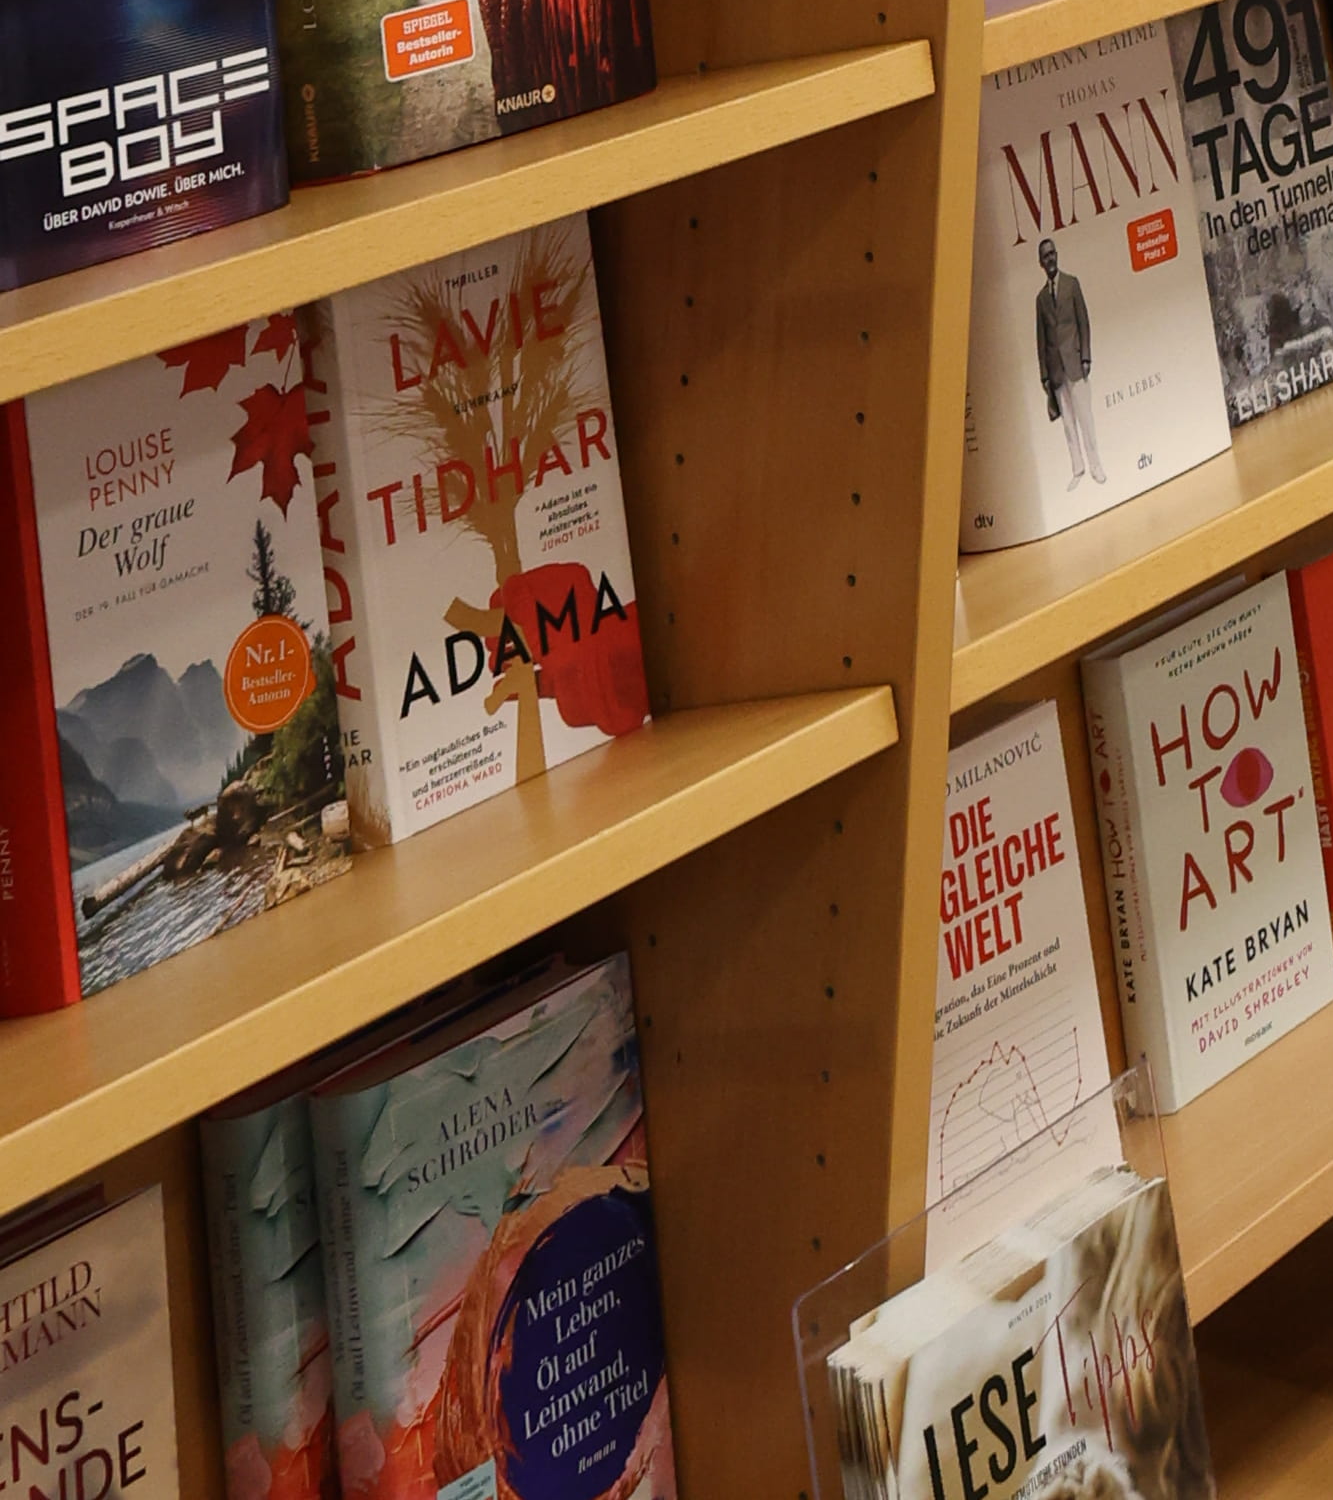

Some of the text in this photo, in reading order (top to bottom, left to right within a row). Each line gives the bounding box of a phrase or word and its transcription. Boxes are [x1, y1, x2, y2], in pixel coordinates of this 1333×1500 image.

[61, 112, 224, 196] BOY
[1001, 88, 1179, 246] MANN
[42, 161, 245, 231] ÜBER DAVID BOWIE. ÜBER MICH.
[445, 264, 498, 290] THRILLER
[1247, 226, 1281, 255] der
[390, 281, 567, 393] LAVIE
[85, 427, 174, 481] LOUISE
[366, 408, 610, 548] TIDHAR
[77, 496, 195, 559] Der graue
[401, 572, 628, 719] ADAMA
[1151, 646, 1282, 787] HOW
[416, 762, 503, 811] CATRIONA WARD
[950, 796, 996, 861] DIE
[1198, 965, 1311, 1054] DAVID SHRIGLEY
[526, 1235, 644, 1326] Mein ganzes
[554, 1295, 621, 1344] Leben,
